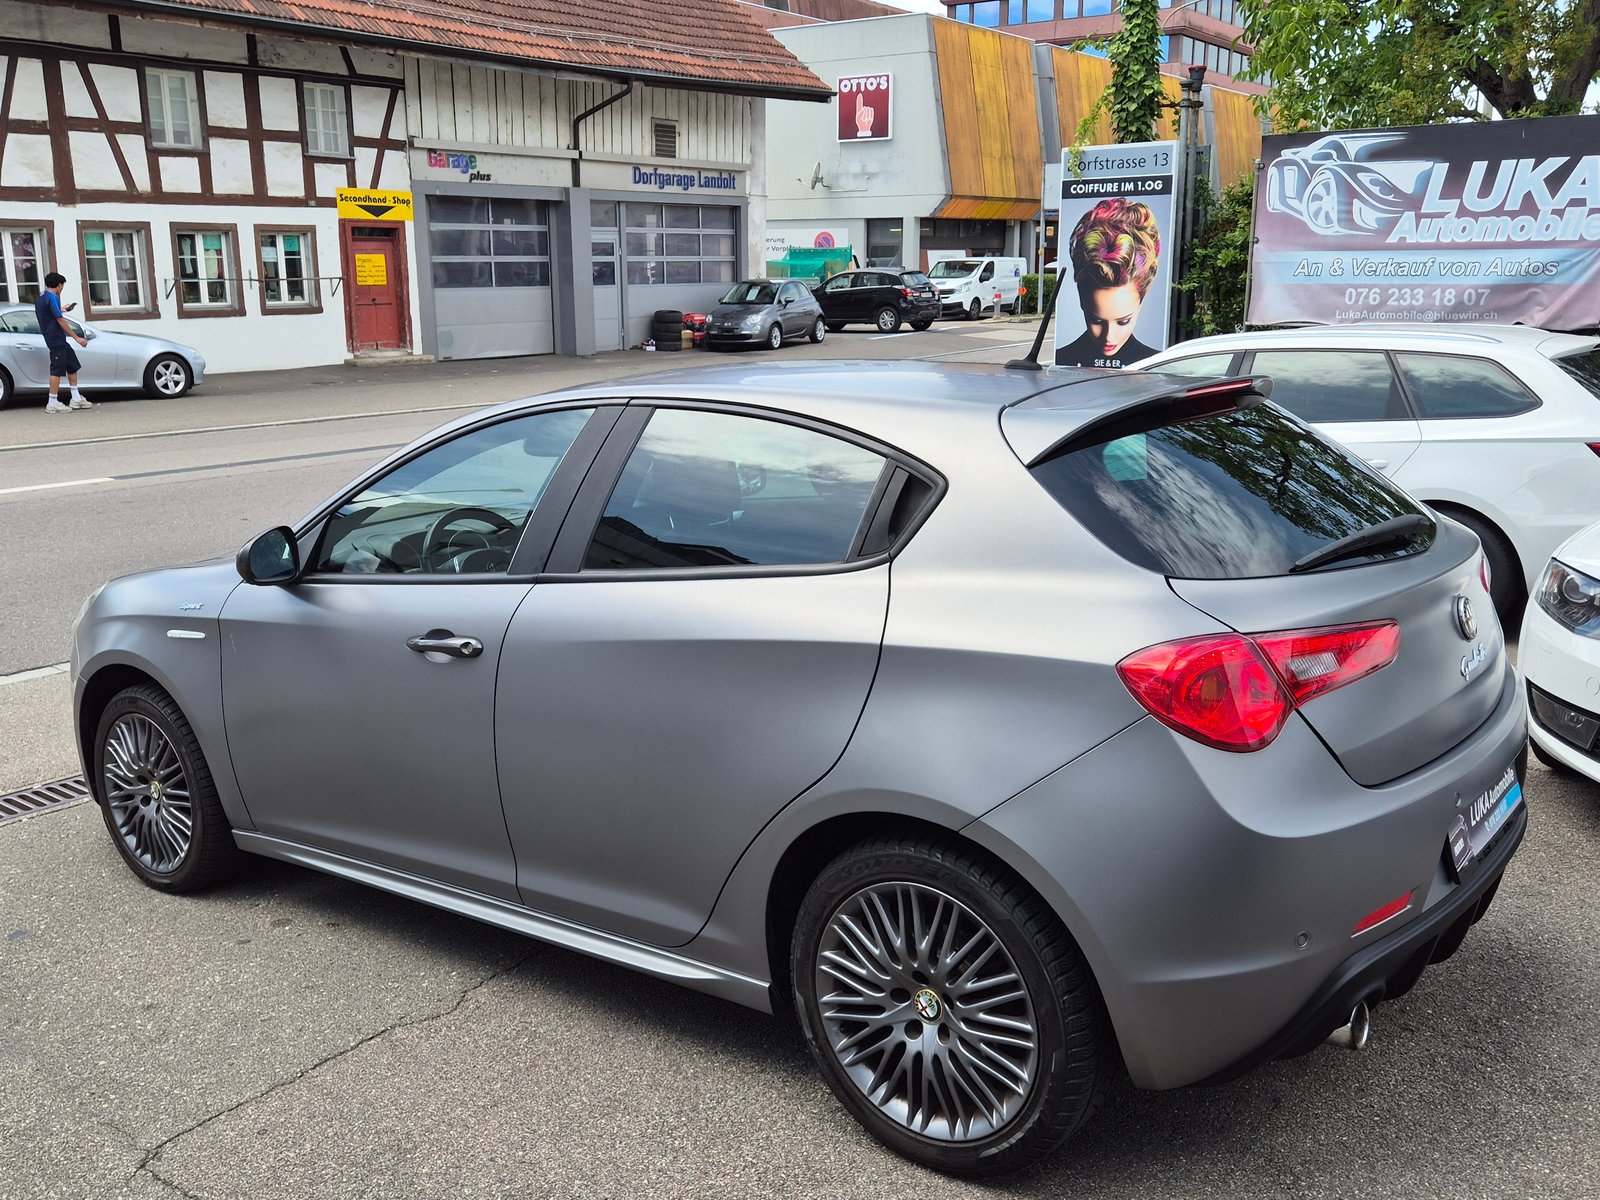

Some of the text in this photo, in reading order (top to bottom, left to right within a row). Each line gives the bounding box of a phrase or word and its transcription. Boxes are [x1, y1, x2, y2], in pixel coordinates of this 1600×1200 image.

[840, 76, 888, 93] OTTO'S
[427, 148, 478, 174] Garage
[1153, 152, 1169, 167] 13
[469, 171, 492, 183] plus
[633, 166, 736, 191] Dorfgarage Landolt
[1420, 155, 1600, 213] LUKA
[1070, 180, 1163, 194] COIFFURE IM 1.OG
[339, 193, 387, 204] Secondhand
[392, 196, 411, 208] Shop
[1385, 207, 1600, 243] Automobile
[1293, 257, 1560, 277] An & Verkauf von Autos
[1344, 287, 1492, 306] 076 233 18 07
[1335, 309, 1498, 322] LukaAutomobile@bluewin.ch
[1094, 358, 1105, 367] SIE
[1112, 359, 1121, 367] ER
[1470, 791, 1491, 827] LUKA
